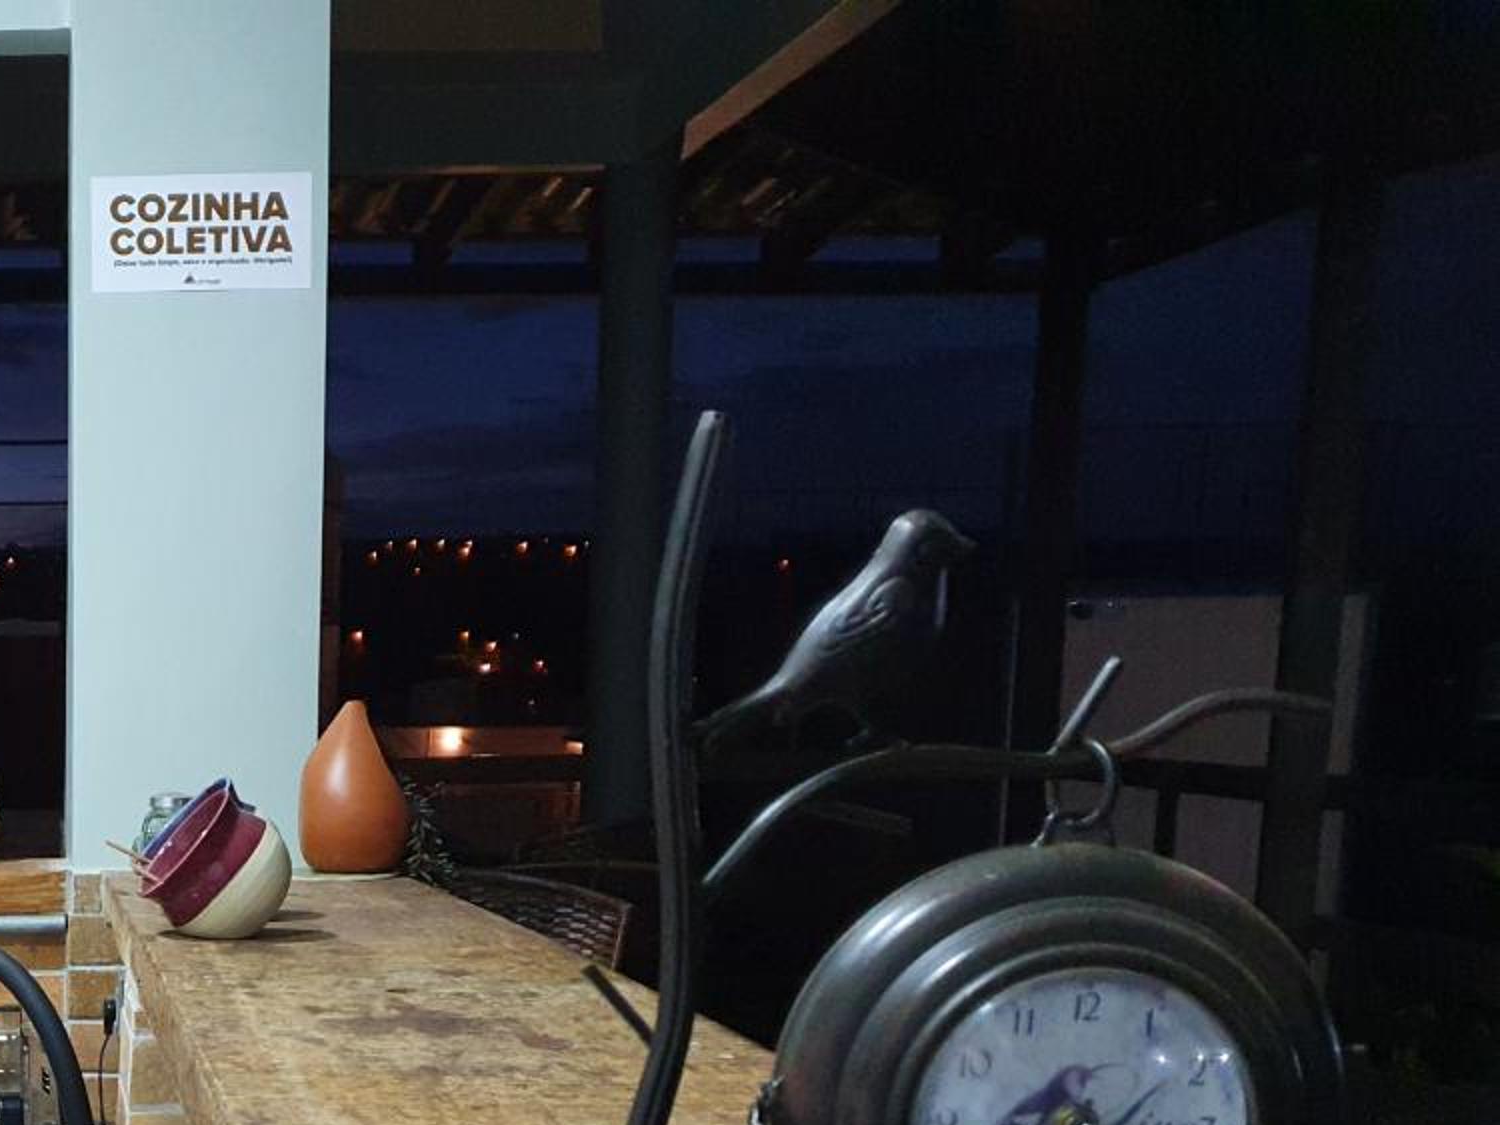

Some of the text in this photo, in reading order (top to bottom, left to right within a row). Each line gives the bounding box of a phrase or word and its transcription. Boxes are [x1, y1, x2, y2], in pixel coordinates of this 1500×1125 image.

[109, 191, 289, 224] COZINHA
[109, 225, 293, 256] COLETIVA
[1013, 1007, 1035, 1037] 11
[1073, 991, 1101, 1023] 12
[1144, 1007, 1155, 1038] 1
[959, 1049, 993, 1080] 10
[1187, 1051, 1207, 1088] 2
